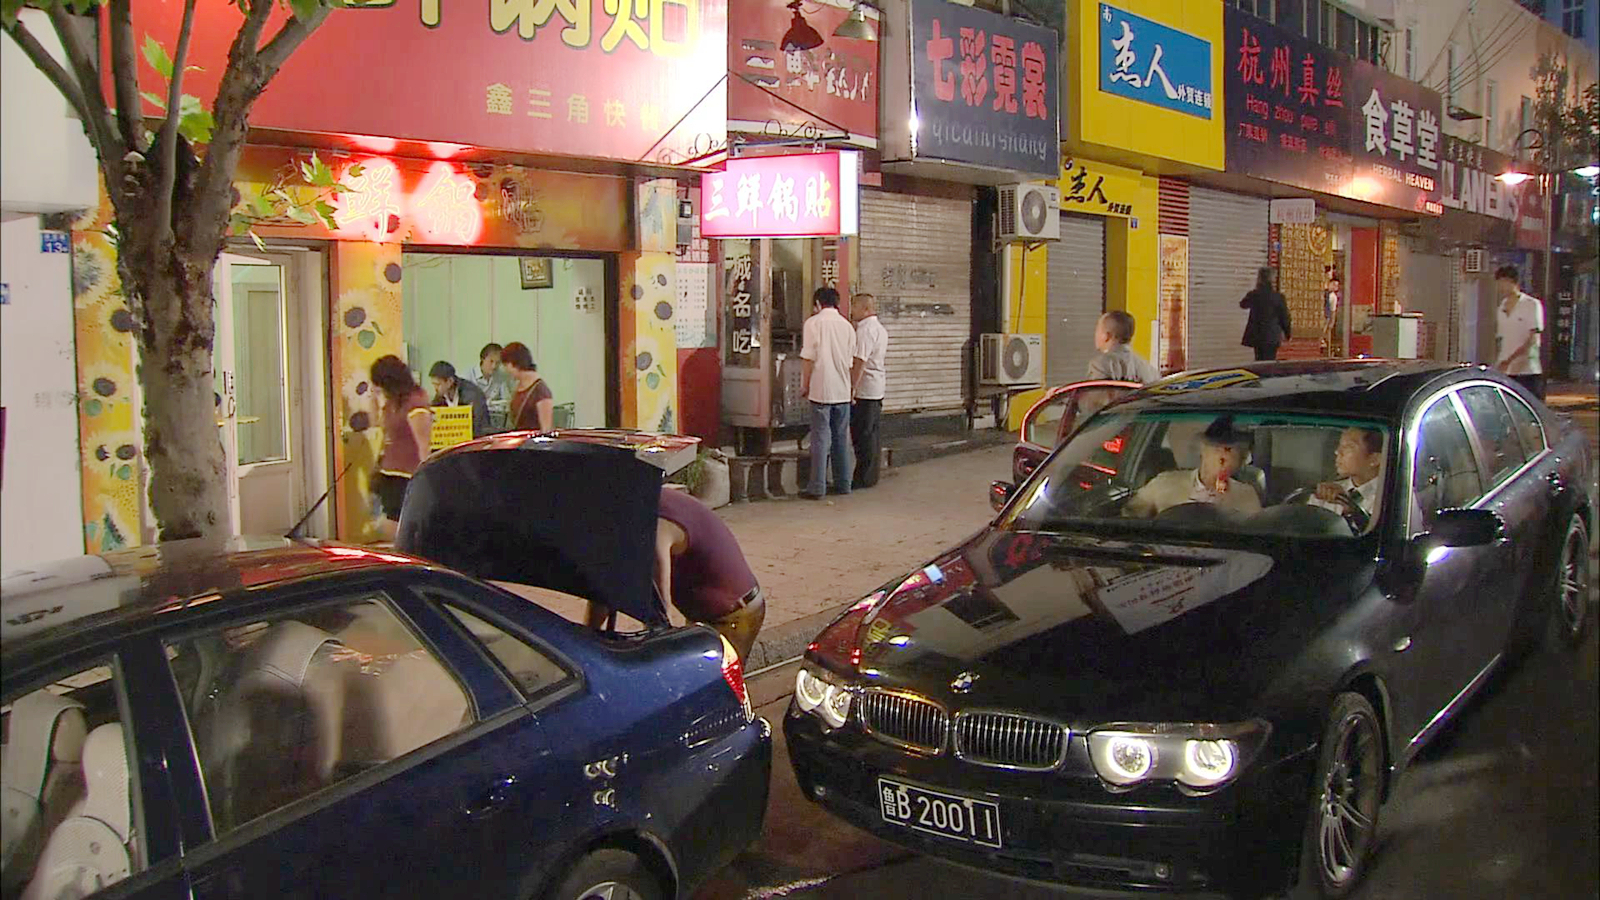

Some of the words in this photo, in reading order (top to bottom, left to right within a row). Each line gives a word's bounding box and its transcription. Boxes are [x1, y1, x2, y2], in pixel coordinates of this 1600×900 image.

[926, 18, 1048, 120] 七彩霓裳
[1237, 27, 1344, 107] 杭州真丝
[1362, 88, 1438, 170] 食草堂
[704, 170, 832, 229] 三鲜锅贴
[1372, 162, 1403, 183] HERBAL
[1405, 172, 1435, 192] HEAVEN
[732, 237, 752, 354] 城名吃
[917, 796, 993, 840] 20011
